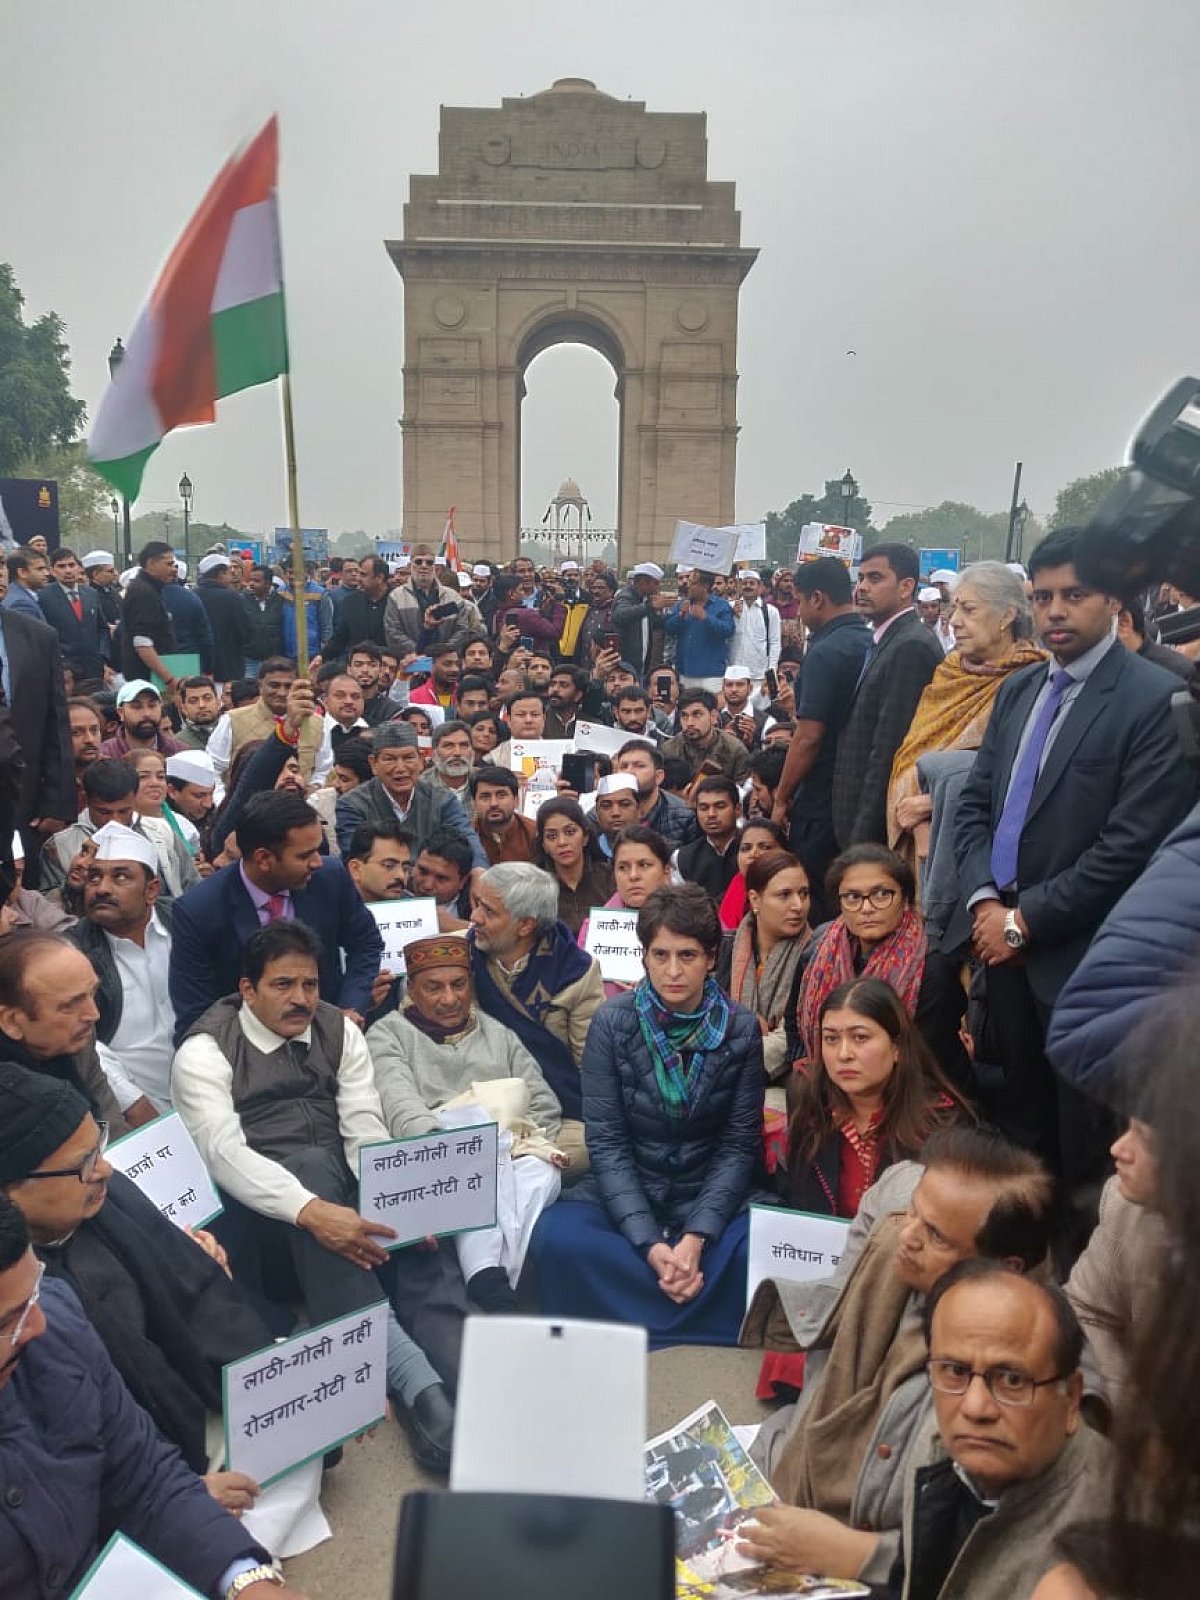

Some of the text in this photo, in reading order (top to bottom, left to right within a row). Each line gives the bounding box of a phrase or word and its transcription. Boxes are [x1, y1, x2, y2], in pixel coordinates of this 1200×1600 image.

[596, 918, 636, 931] लाठी-गो
[593, 943, 643, 957] रोजगार-रो
[156, 1145, 173, 1159] पर
[373, 1134, 482, 1172] लाठी-गोली नहीं
[178, 1188, 197, 1207] करो
[373, 1172, 482, 1210] रोजगार-रोटी दो
[771, 1242, 824, 1264] संविधान
[242, 1317, 373, 1390] लाठी-गोली नहीं
[243, 1361, 372, 1437] रोजगार-रोटी दो
